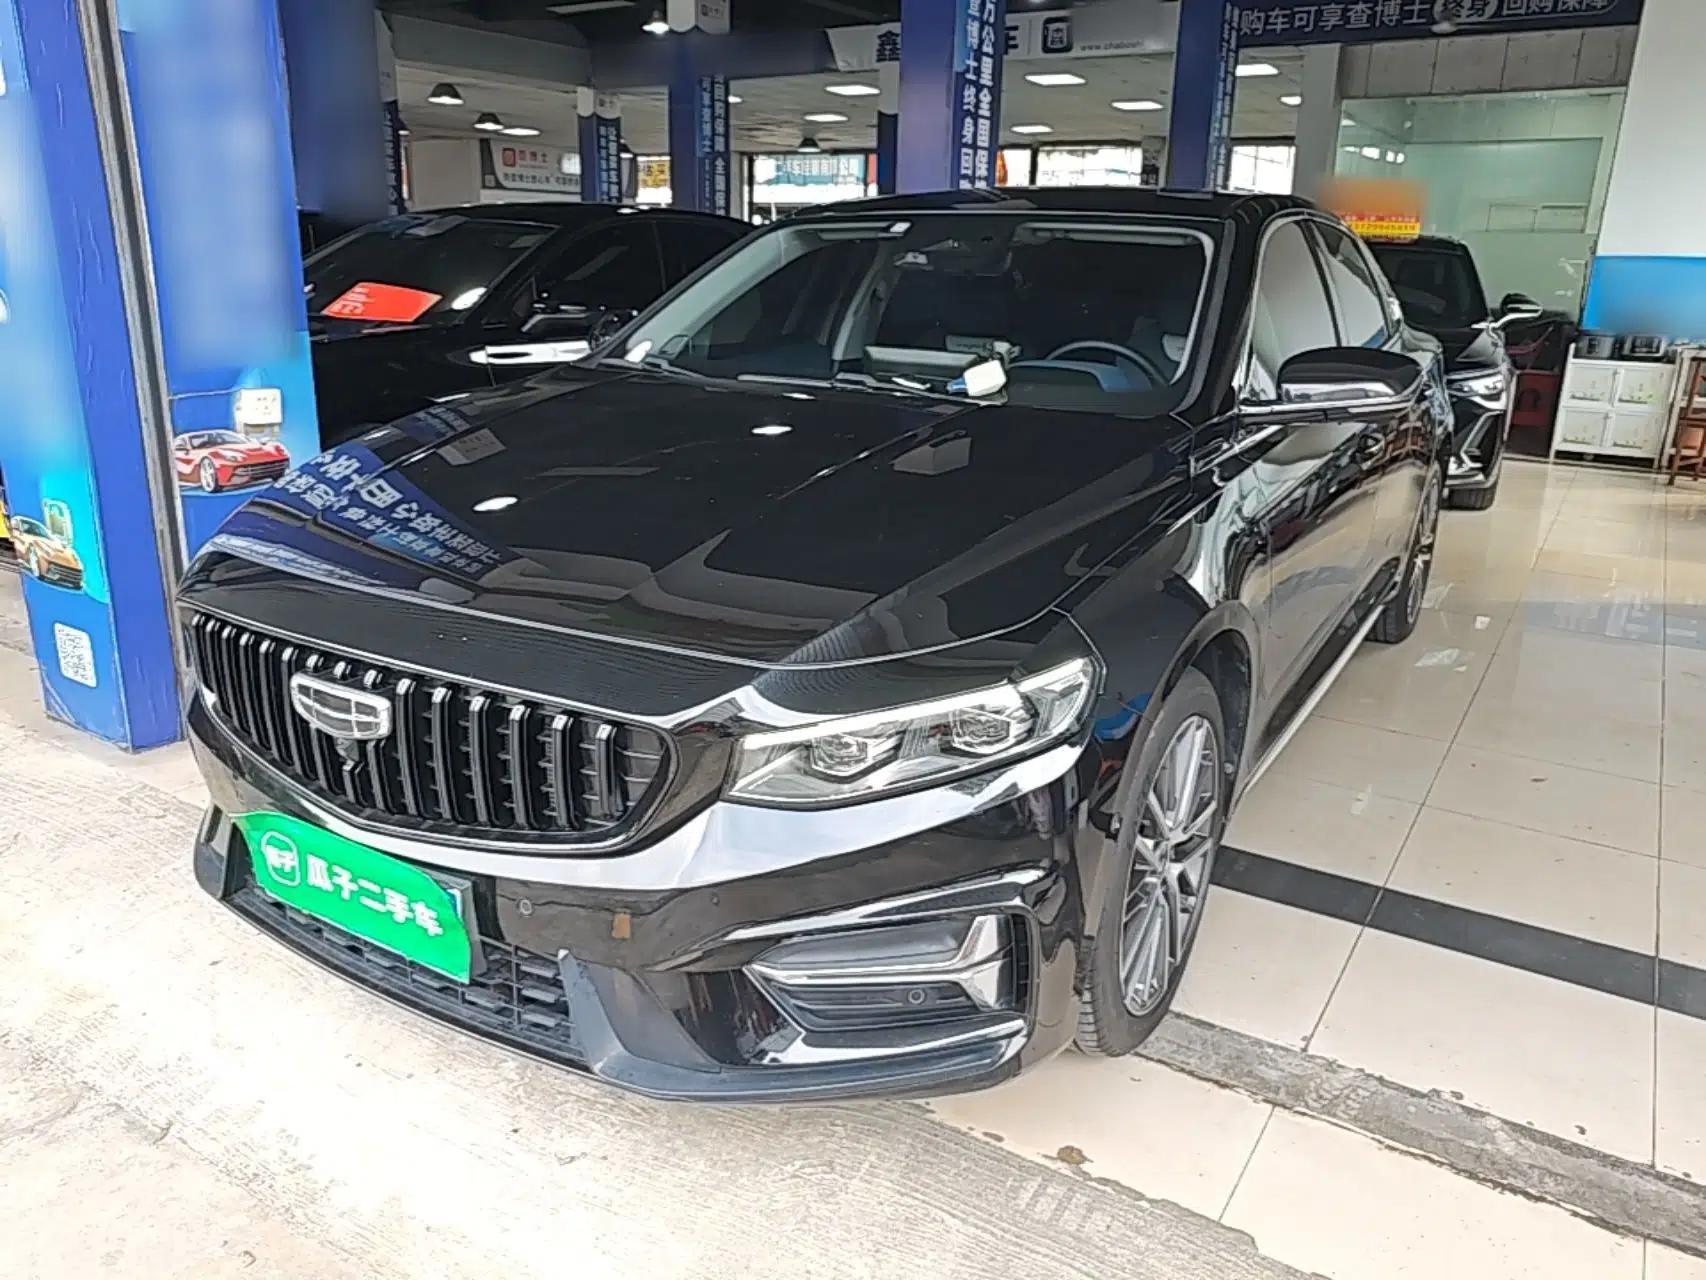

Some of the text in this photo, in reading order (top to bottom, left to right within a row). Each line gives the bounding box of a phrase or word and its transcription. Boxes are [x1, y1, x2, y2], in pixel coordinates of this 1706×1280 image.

[305, 853, 445, 937] 瓜子二手车
